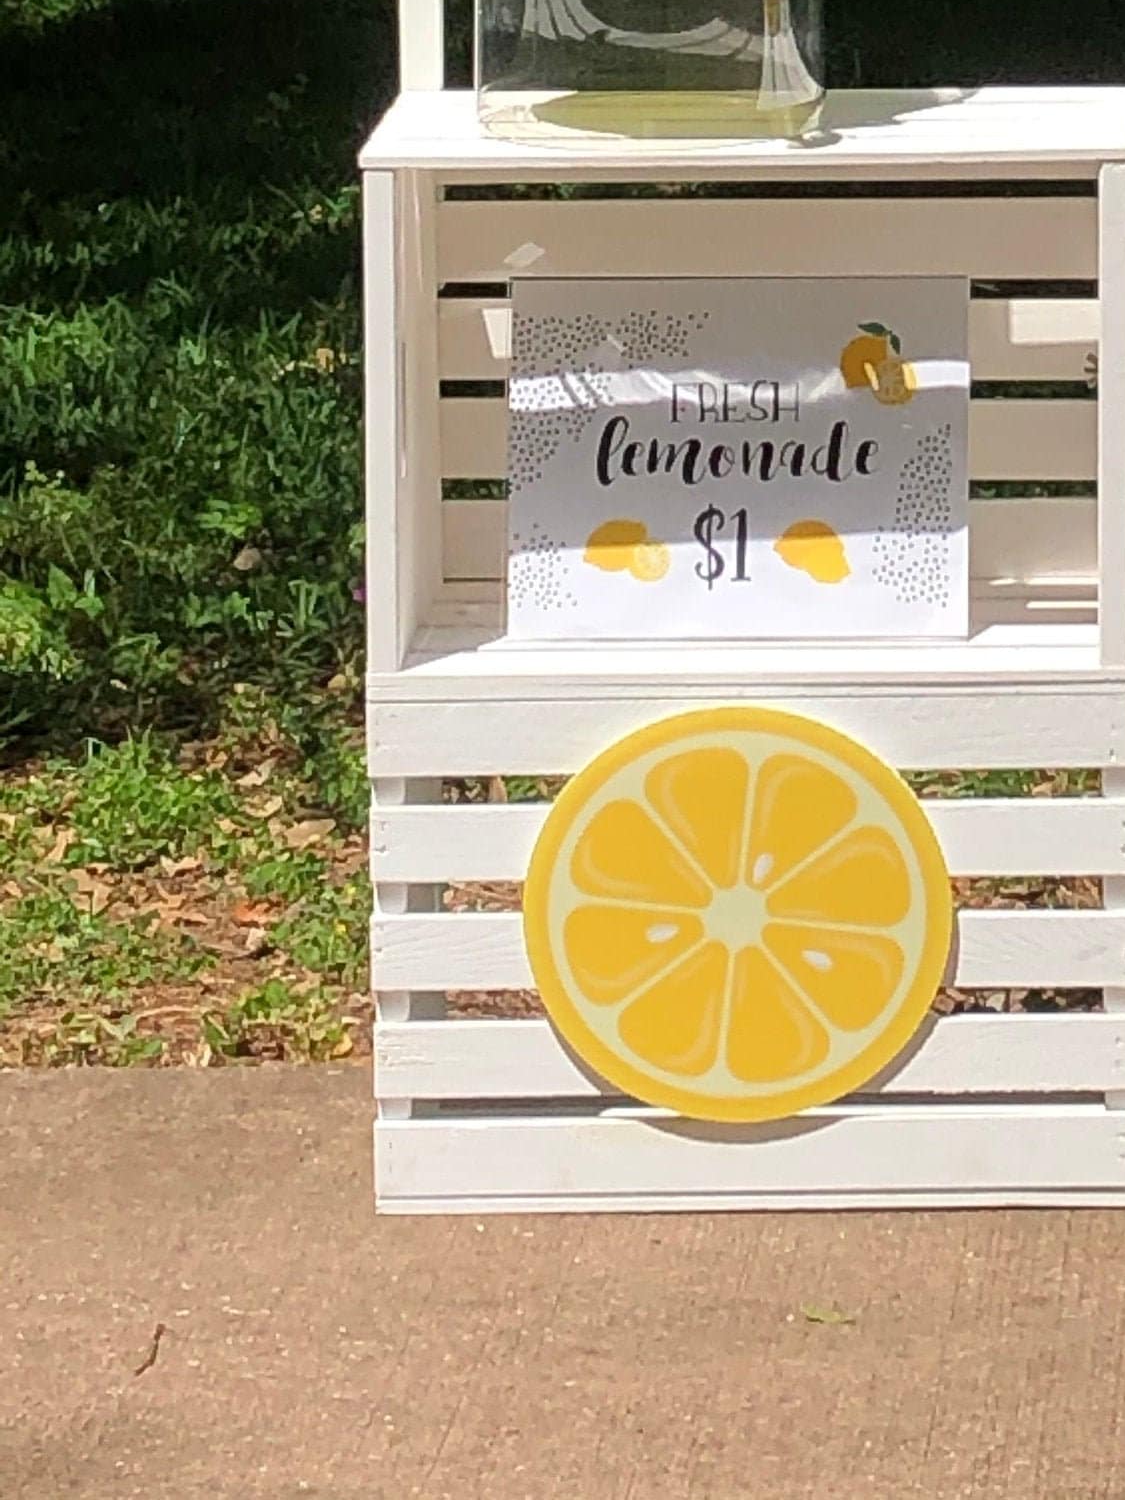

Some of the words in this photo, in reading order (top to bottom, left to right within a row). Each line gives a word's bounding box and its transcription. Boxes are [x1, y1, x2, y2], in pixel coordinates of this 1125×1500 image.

[671, 380, 801, 423] FRESH
[597, 415, 879, 487] lemonade
[693, 503, 751, 591] $1
